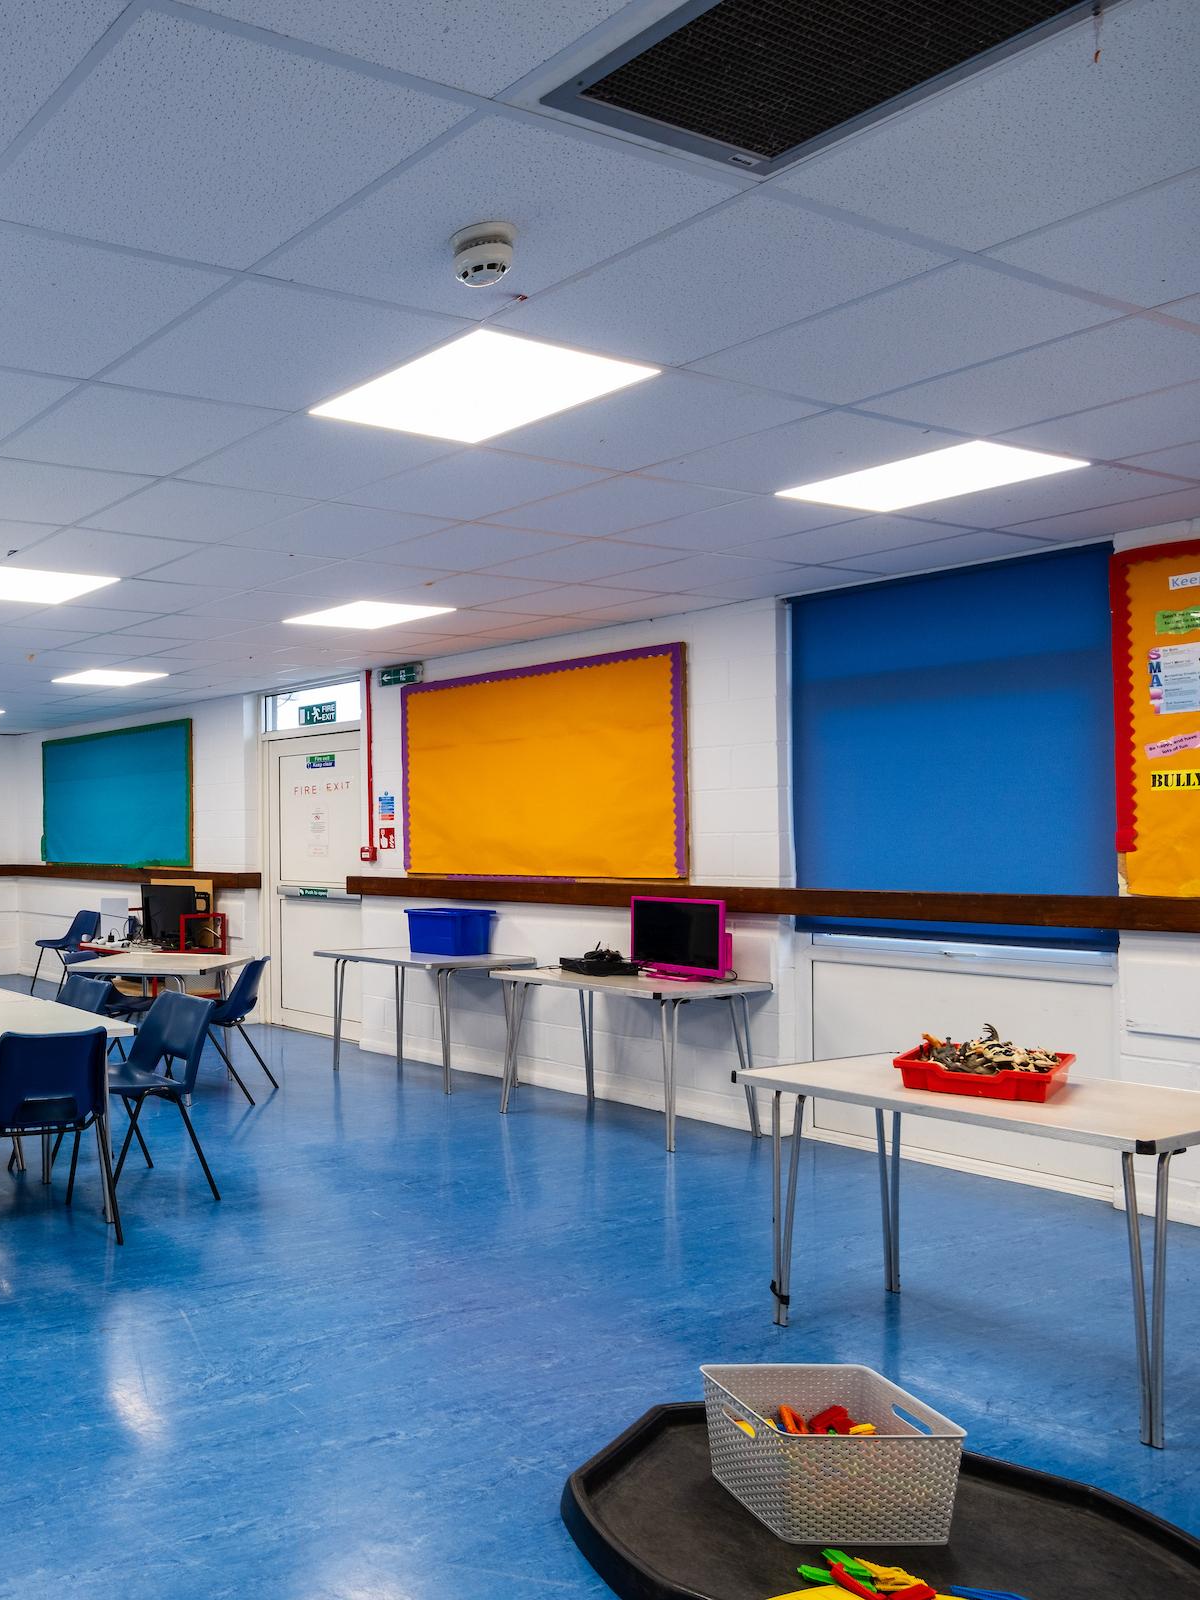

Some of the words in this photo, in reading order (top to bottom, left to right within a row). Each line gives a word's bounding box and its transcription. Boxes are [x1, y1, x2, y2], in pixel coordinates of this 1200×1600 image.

[1171, 576, 1200, 588] Kee
[322, 704, 335, 713] FIRE
[294, 785, 317, 796] FIRE
[326, 781, 350, 791] EXIT
